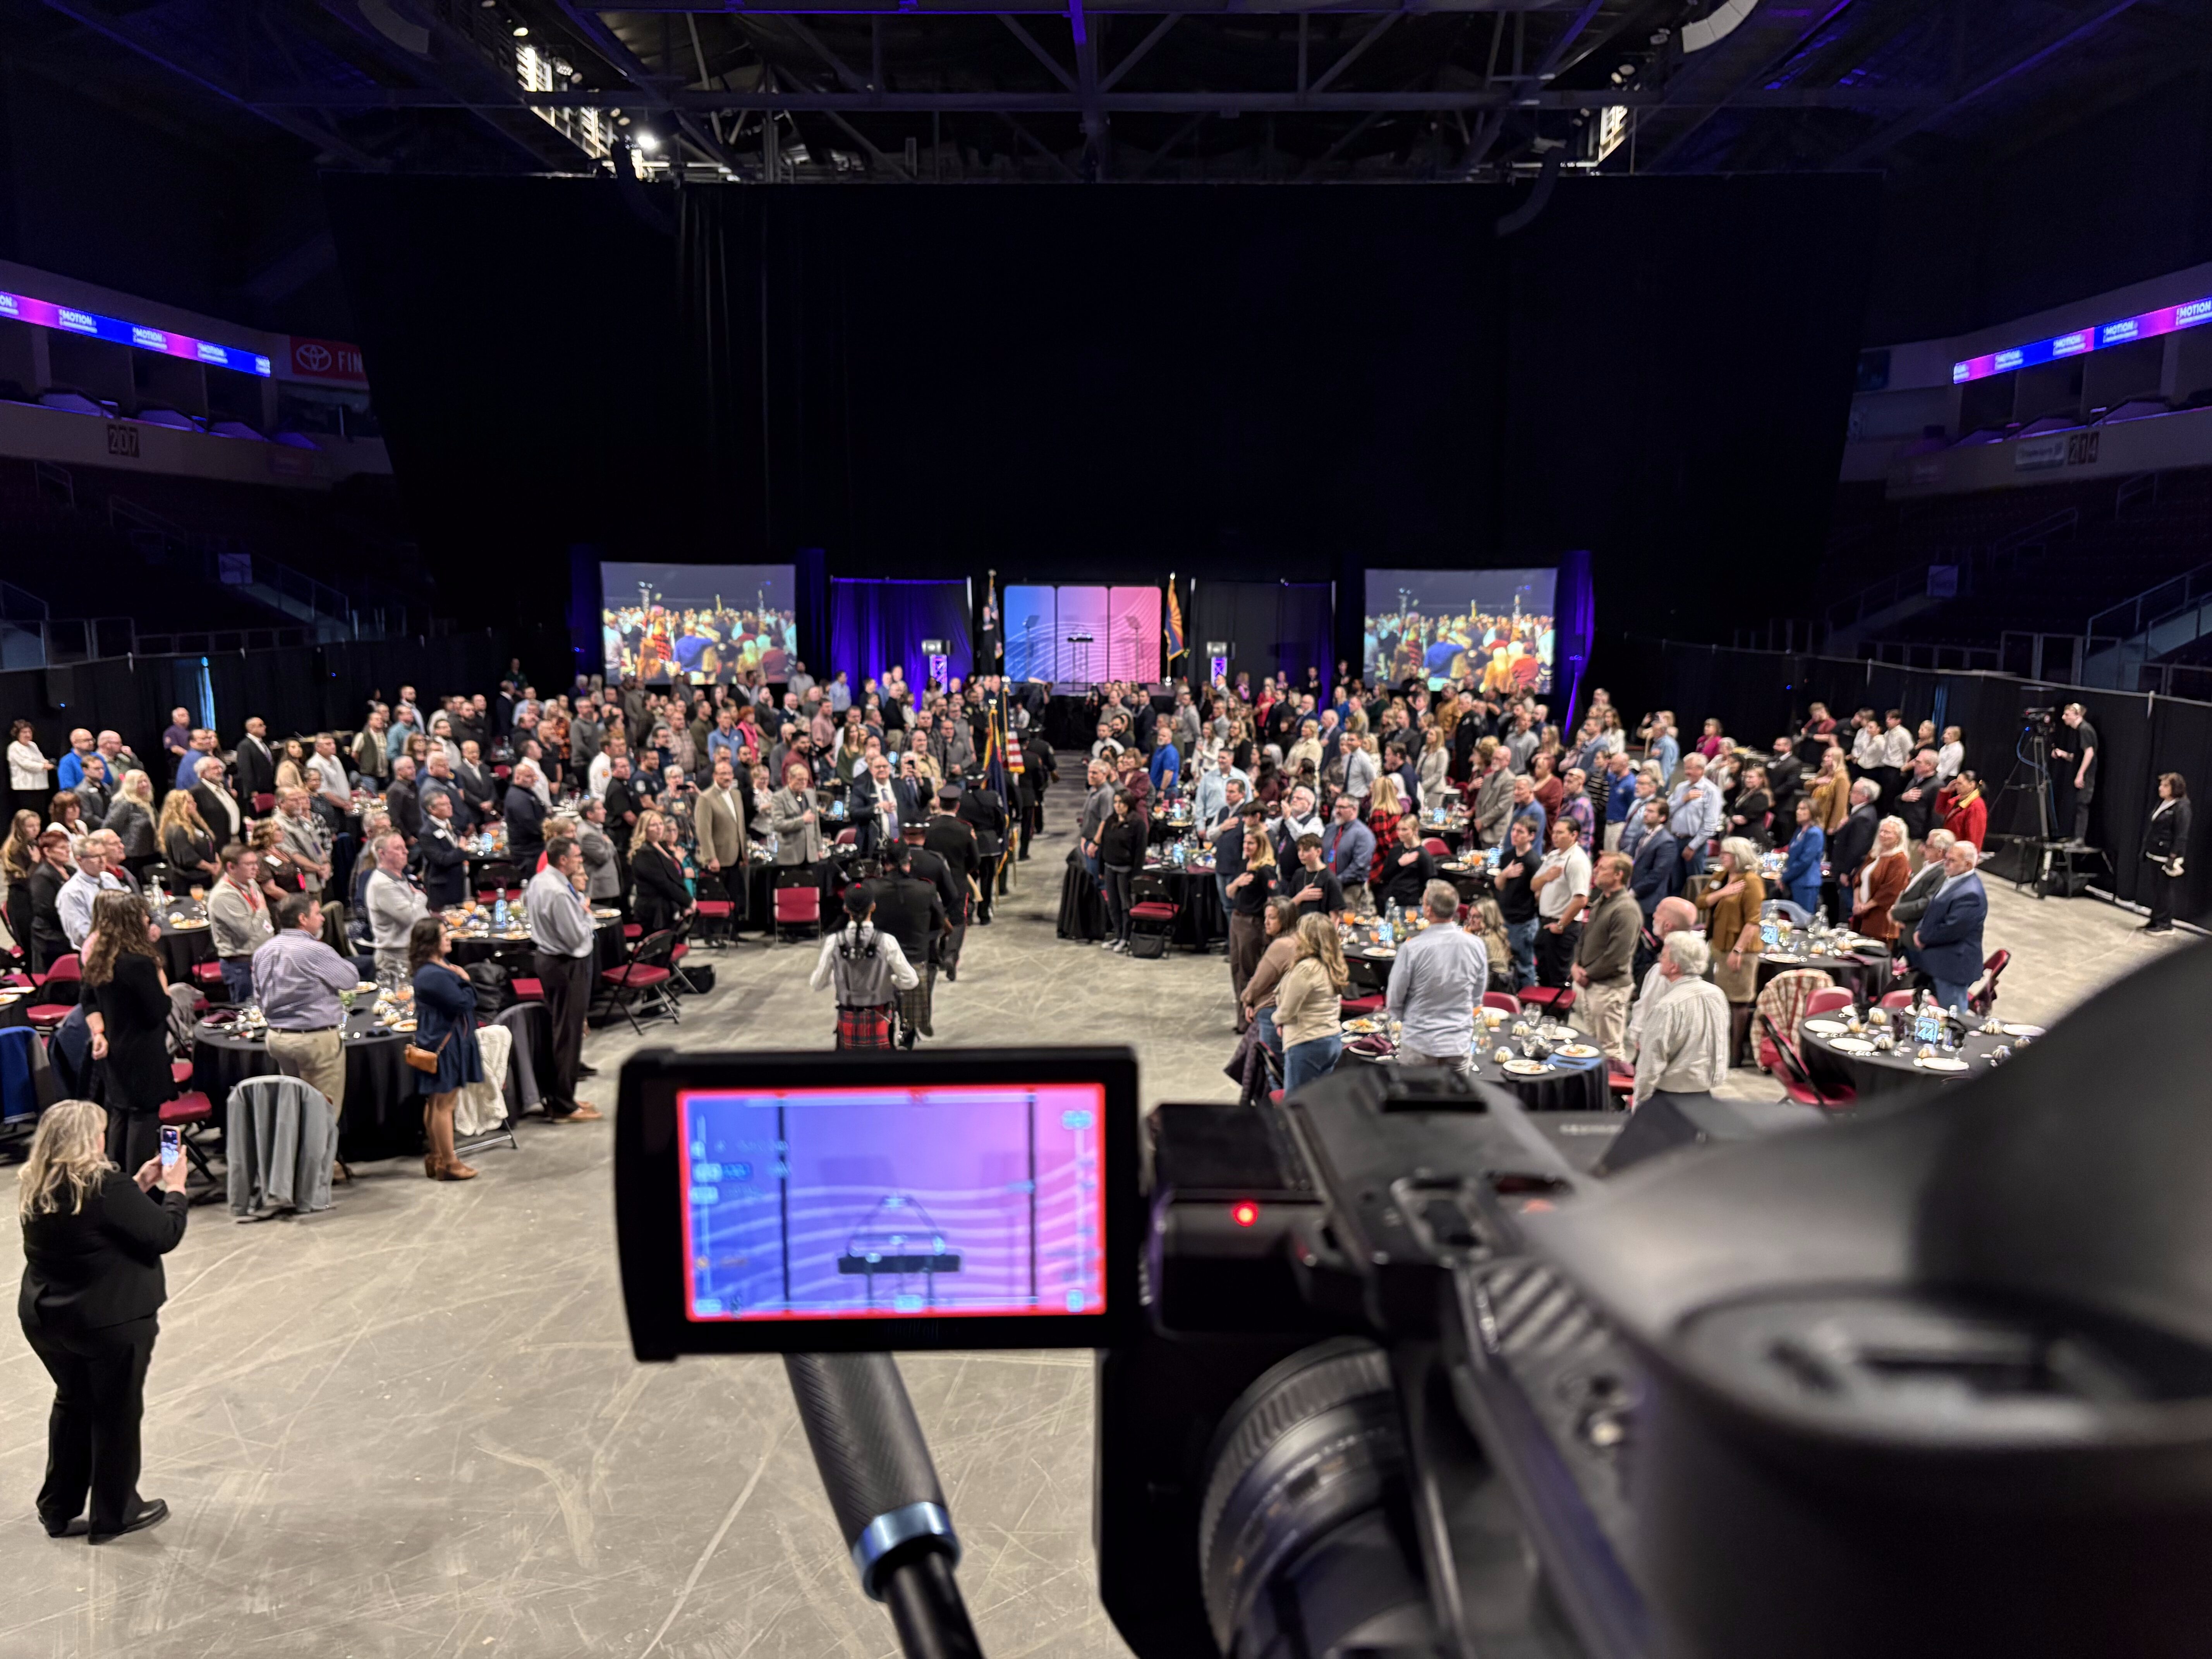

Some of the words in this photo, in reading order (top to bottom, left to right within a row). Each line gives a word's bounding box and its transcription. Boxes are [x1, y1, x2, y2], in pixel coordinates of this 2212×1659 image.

[2179, 300, 2212, 318] MOTION
[62, 309, 92, 326] MOTION
[136, 327, 162, 342] MOTION
[2106, 320, 2134, 335] MOTION
[108, 426, 138, 456] 207
[1917, 1027, 1934, 1041] 44
